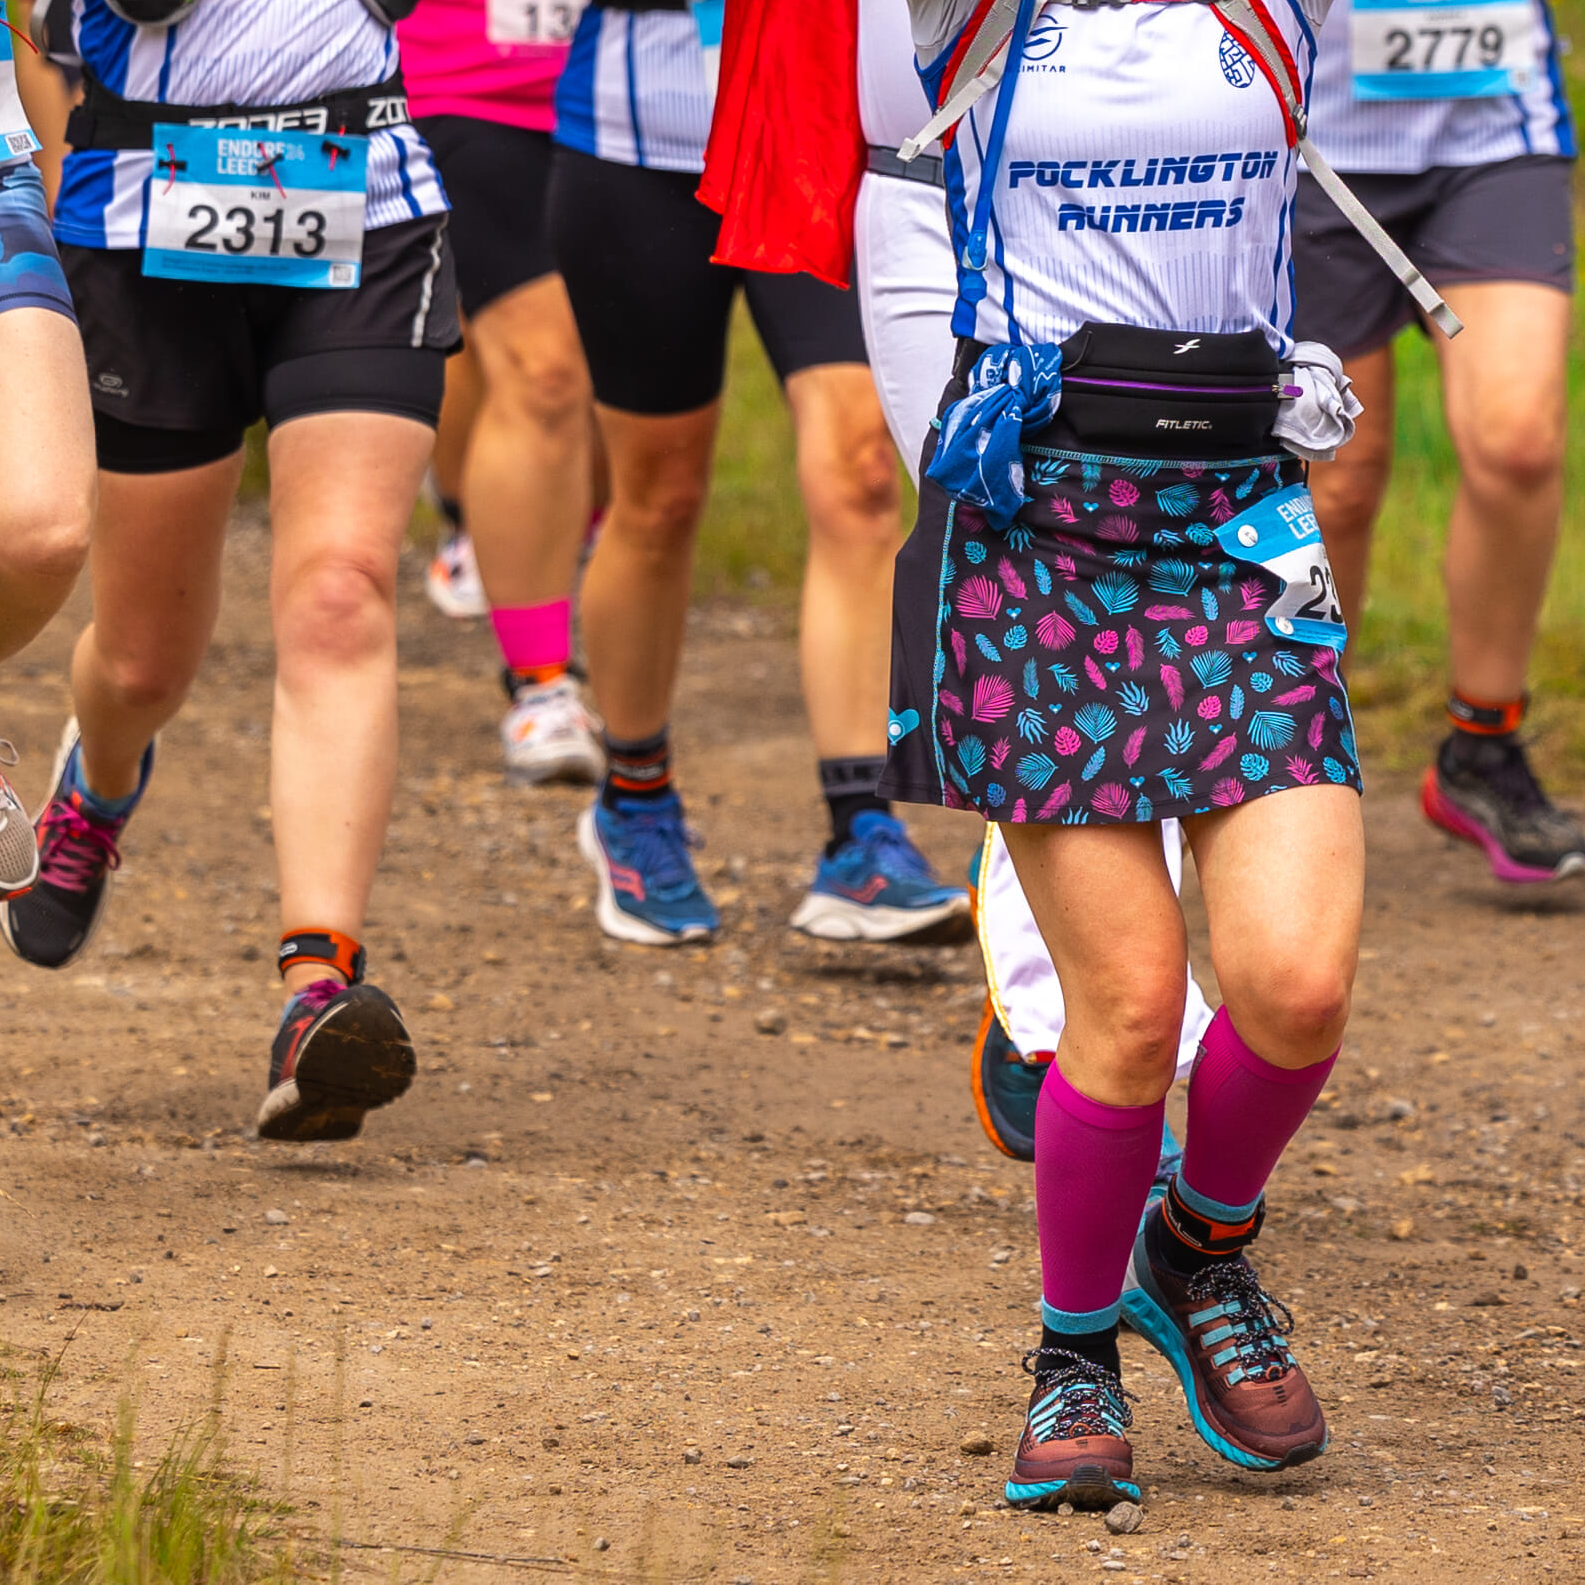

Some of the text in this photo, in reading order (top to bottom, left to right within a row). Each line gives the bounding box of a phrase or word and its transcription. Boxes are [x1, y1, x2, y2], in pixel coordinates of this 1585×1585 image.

[1385, 24, 1504, 71] 2779
[1018, 65, 1066, 73] IMITAR
[1009, 151, 1278, 189] POCKLINGTON
[251, 191, 271, 200] KIM
[185, 204, 326, 258] 2313
[1058, 197, 1245, 233] RUNNERS
[1155, 418, 1210, 430] FITLETIC
